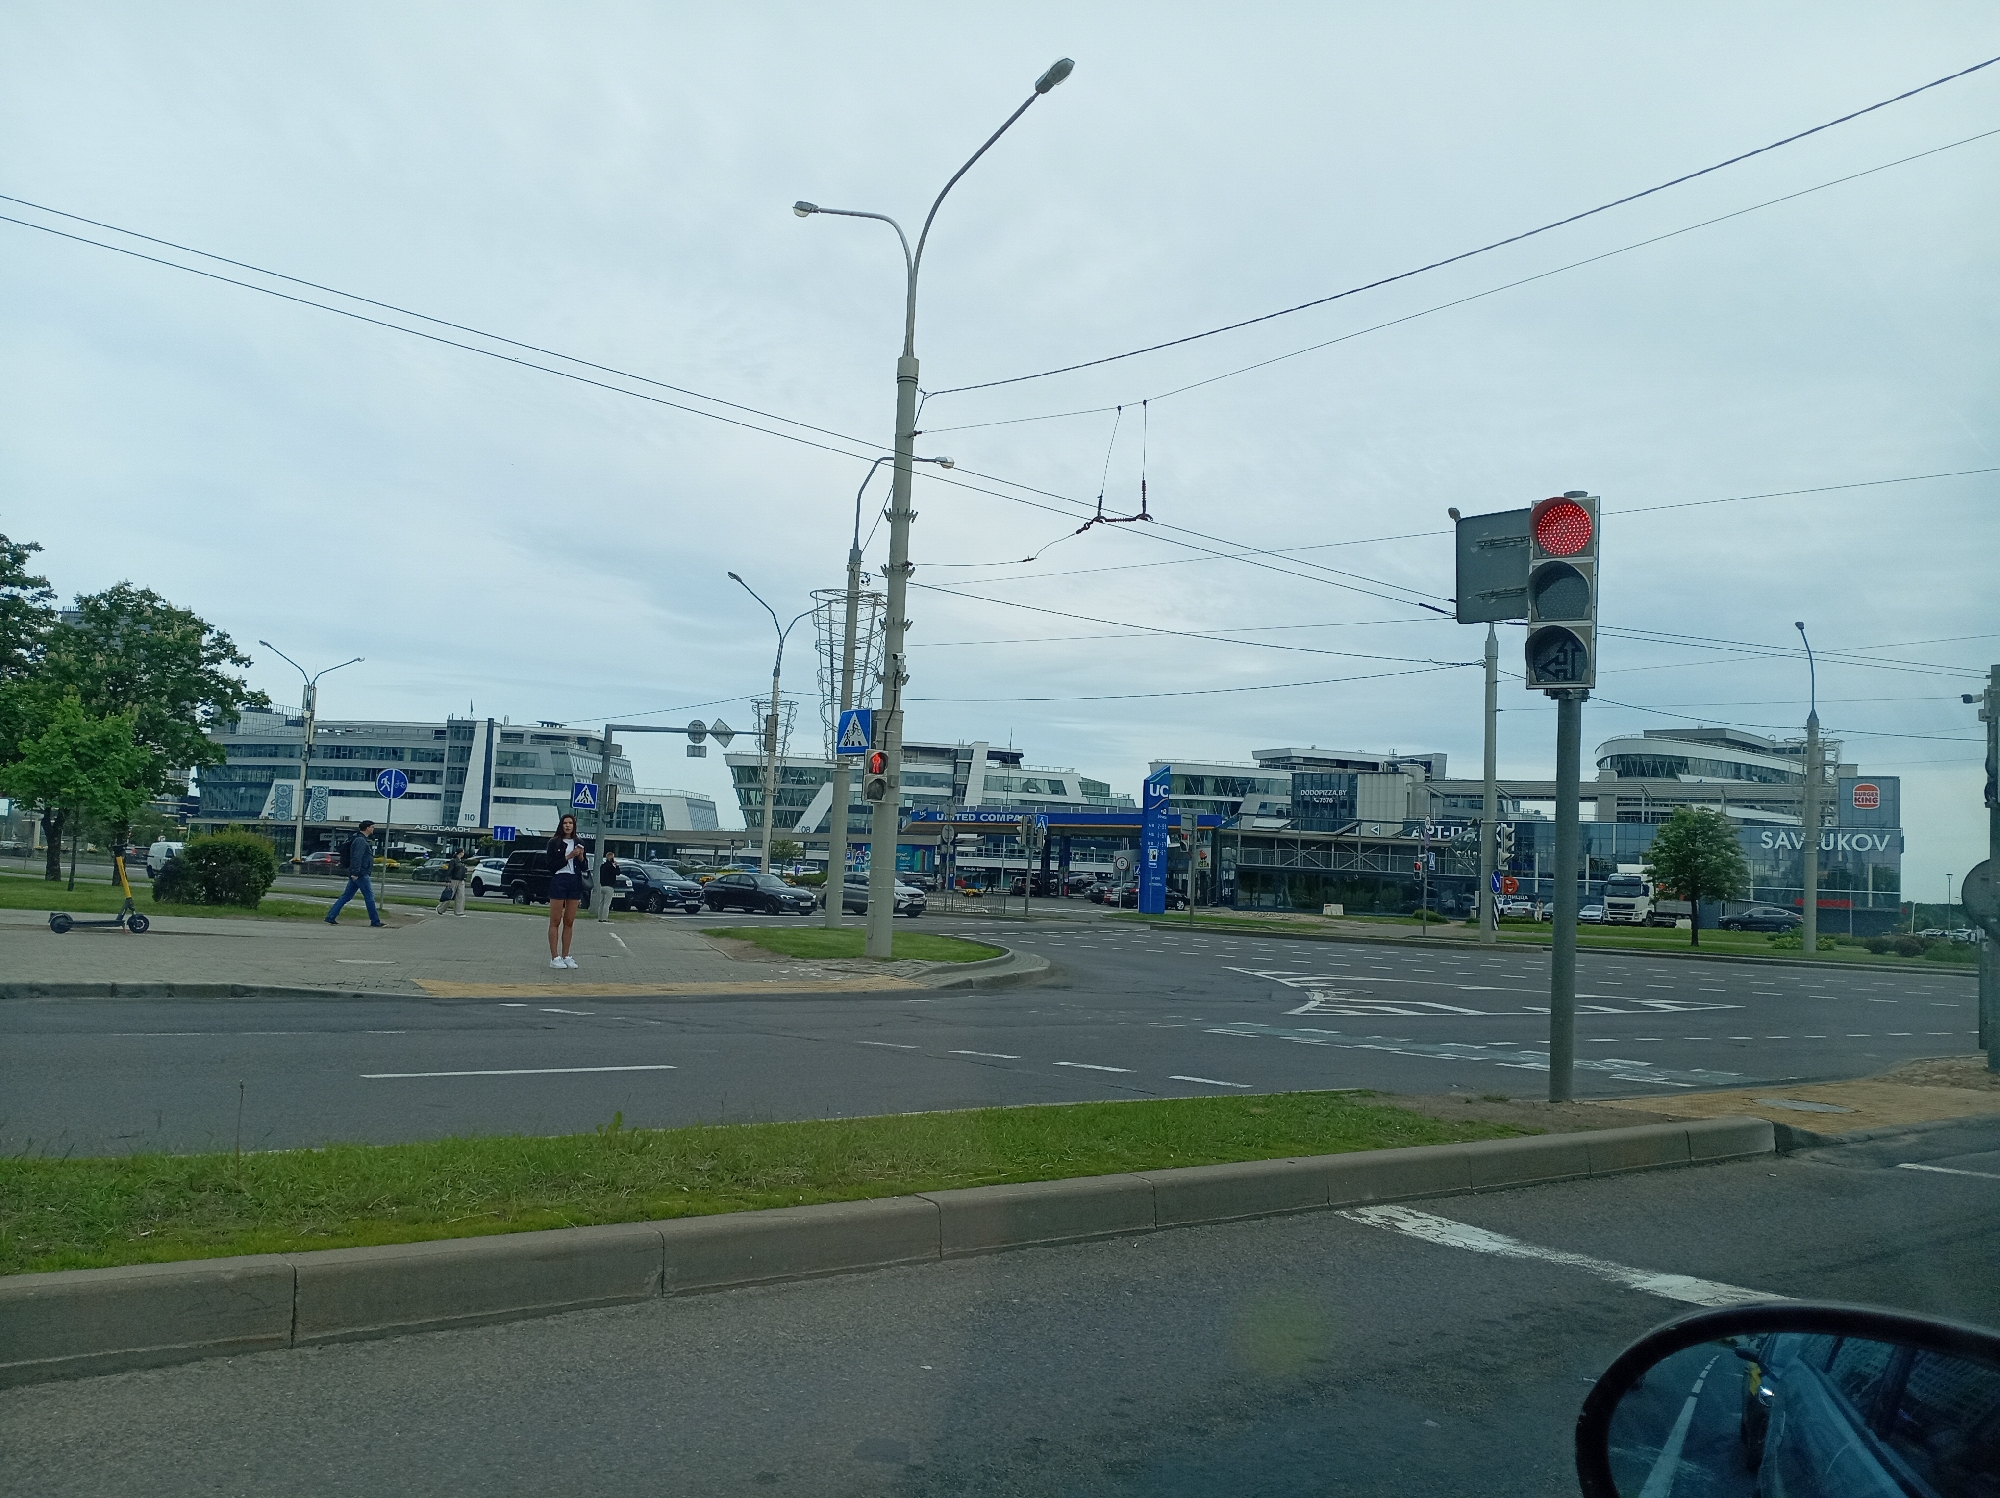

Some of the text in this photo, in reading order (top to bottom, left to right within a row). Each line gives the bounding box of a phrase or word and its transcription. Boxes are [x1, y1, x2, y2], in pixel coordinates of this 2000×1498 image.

[1150, 783, 1169, 798] UC
[1854, 796, 1879, 804] KING
[464, 813, 476, 822] 110
[414, 824, 471, 833] АВТОСАЛОН
[1760, 831, 1891, 851] SAVUKOV
